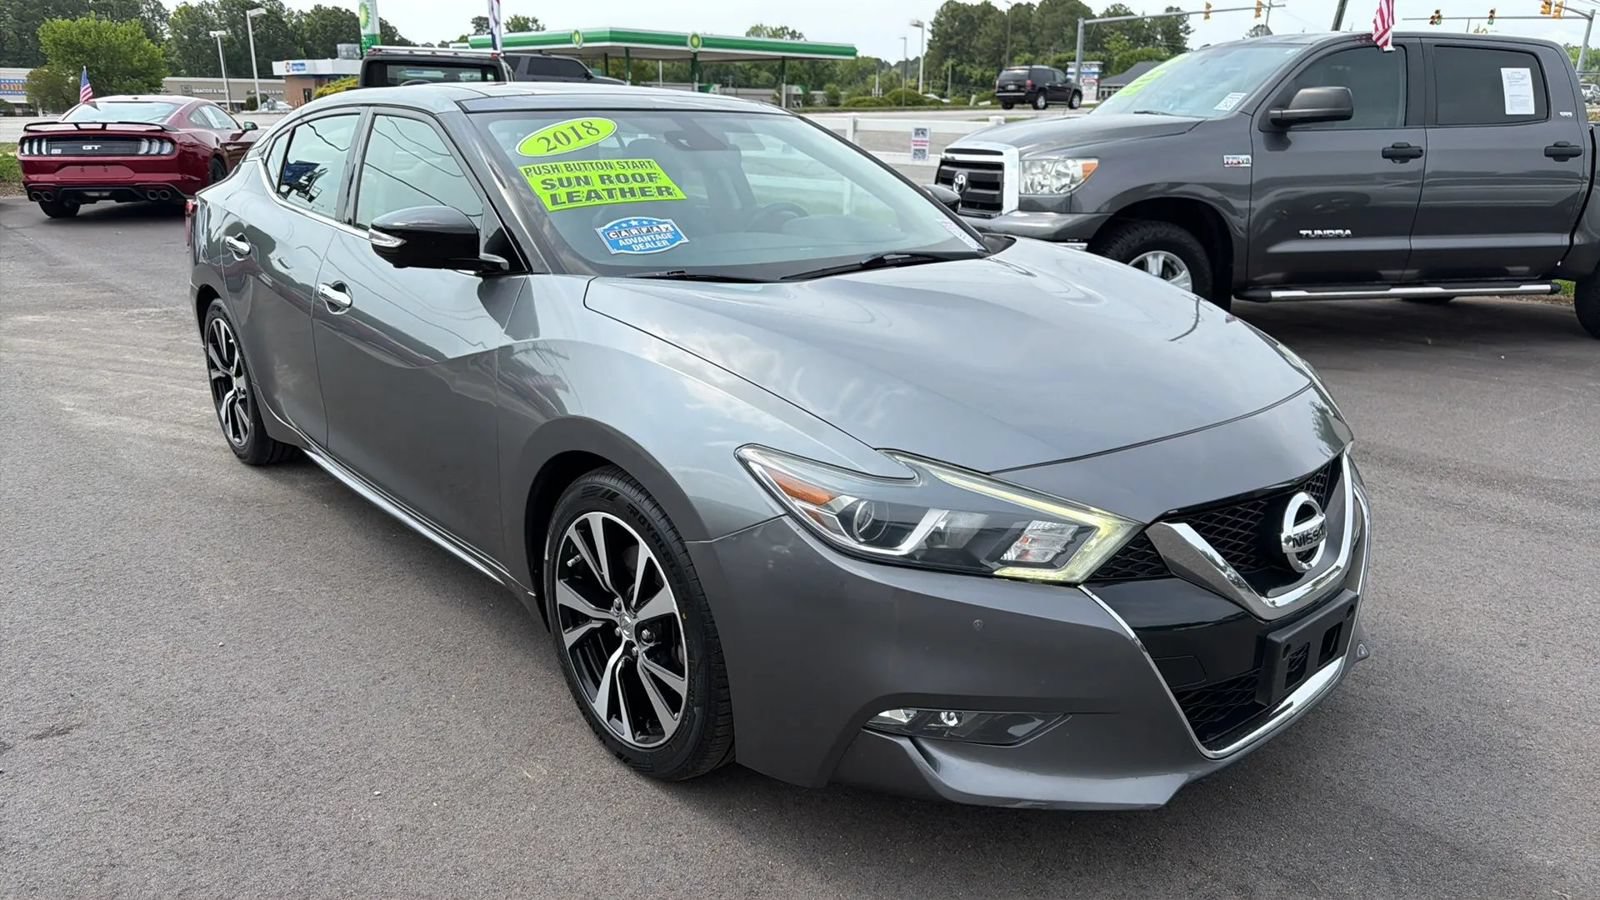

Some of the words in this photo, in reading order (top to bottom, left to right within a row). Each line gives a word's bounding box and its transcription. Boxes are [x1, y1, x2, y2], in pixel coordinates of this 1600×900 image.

[537, 121, 600, 152] 2018
[524, 164, 561, 177] PUSH
[563, 160, 614, 172] BUTTON
[617, 159, 654, 170] START
[541, 175, 592, 190] SUN
[600, 172, 660, 185] ROOF
[550, 185, 674, 206] LEATHER
[608, 224, 674, 239] CARFAX
[618, 232, 674, 246] ADVANTAGE
[1299, 229, 1352, 238] TUNDRA
[632, 240, 670, 251] DEALER
[1292, 527, 1325, 549] NISSA
